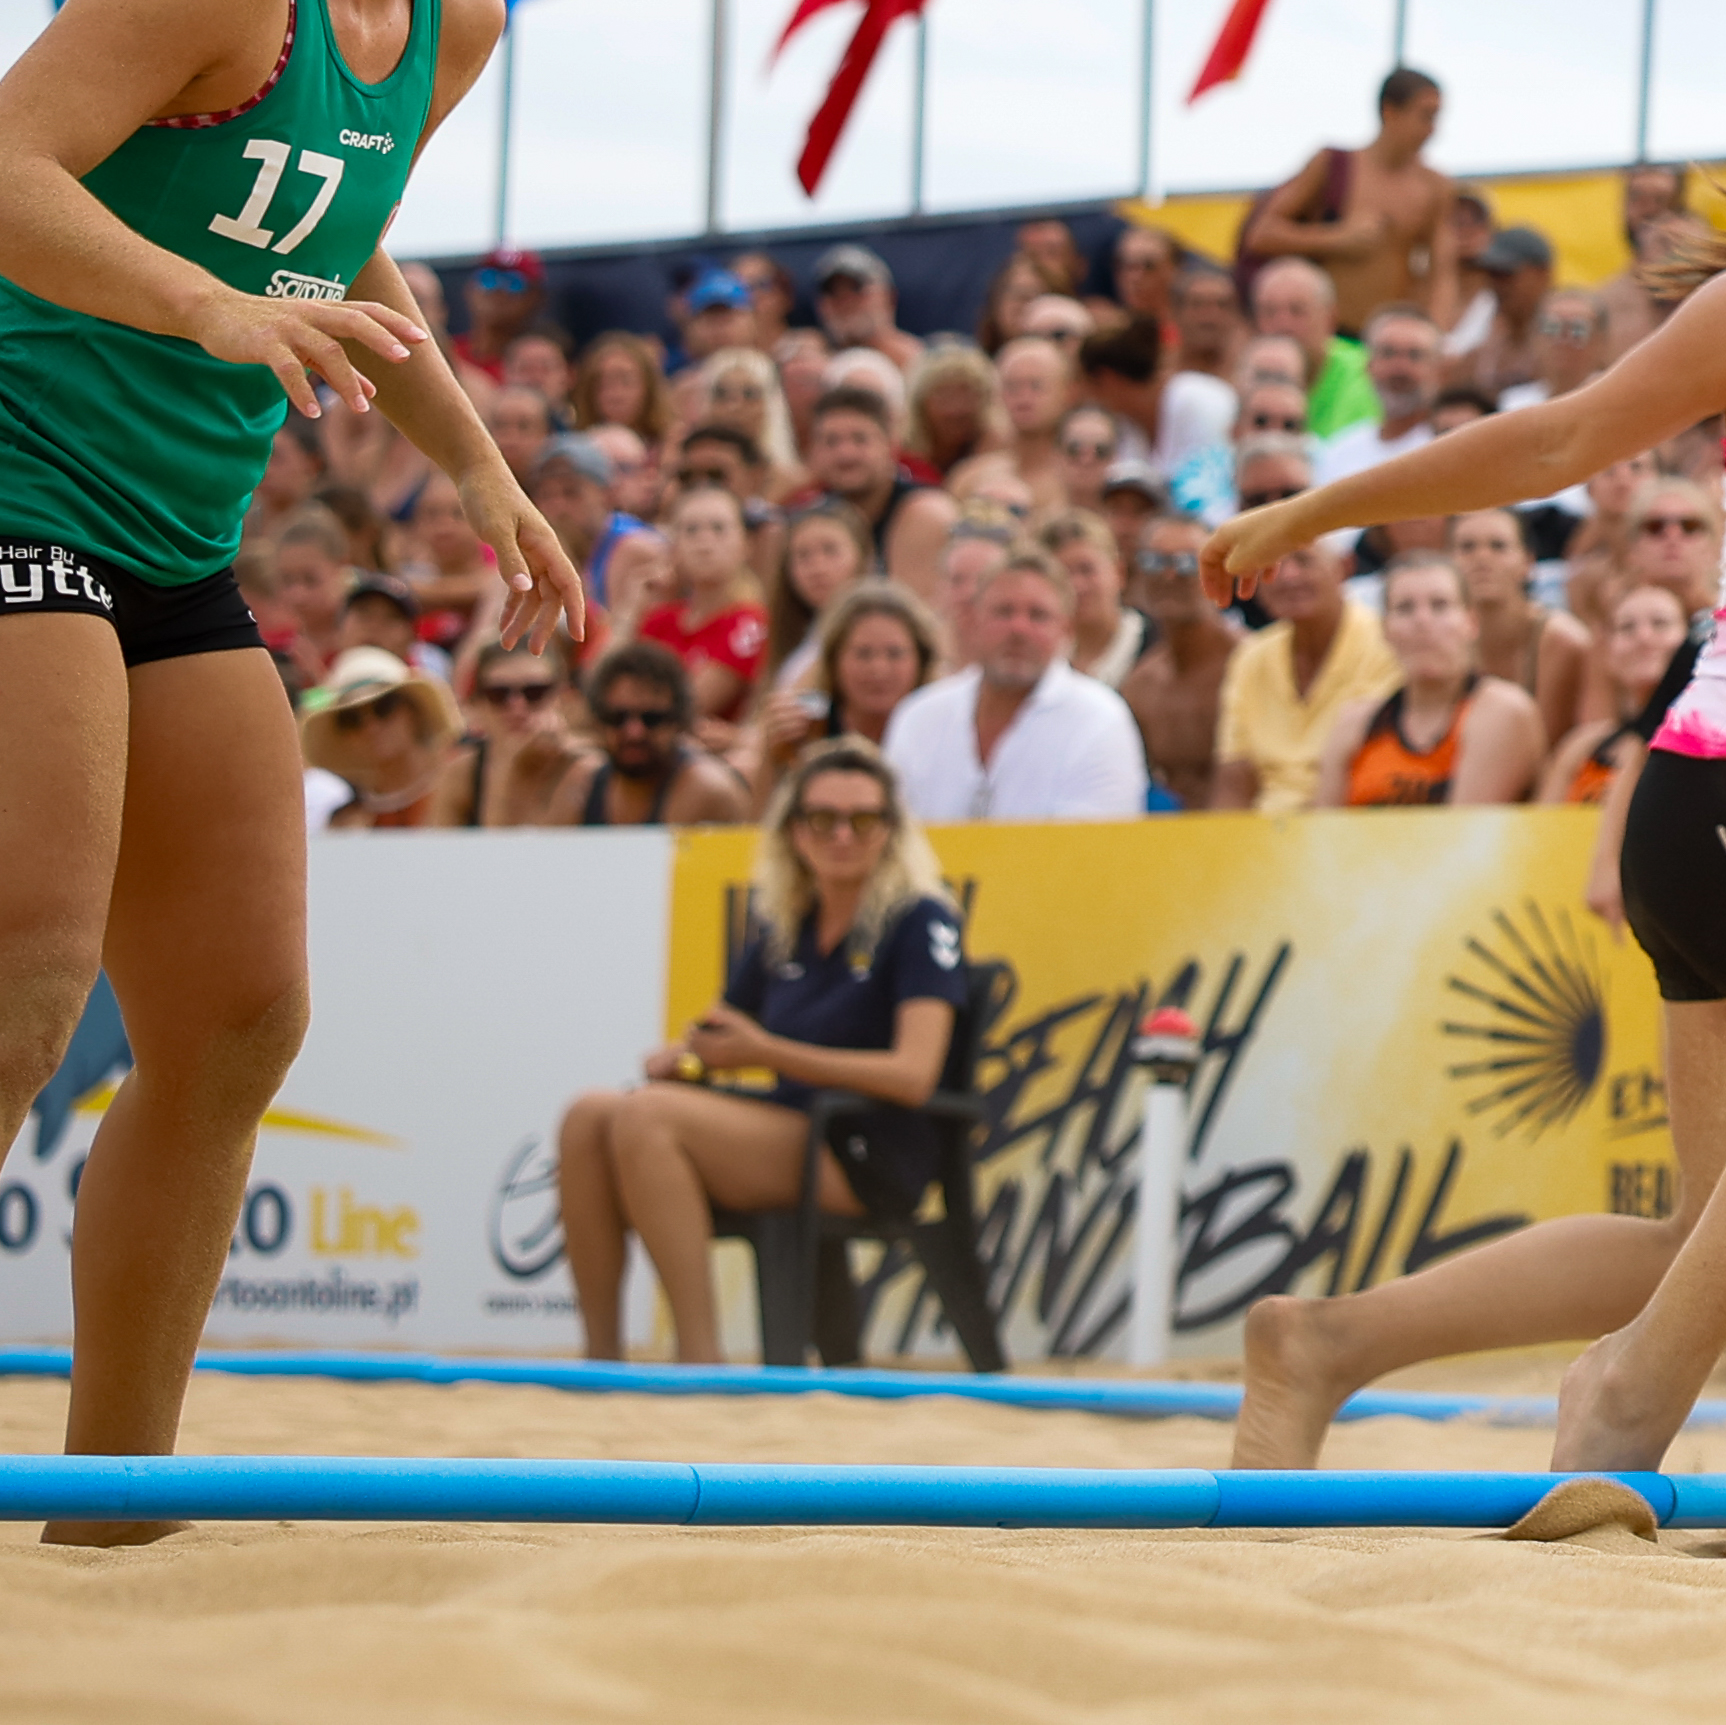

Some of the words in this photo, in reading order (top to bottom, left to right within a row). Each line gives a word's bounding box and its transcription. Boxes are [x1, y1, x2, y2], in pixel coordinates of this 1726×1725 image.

[339, 128, 384, 151] CRAFT
[208, 139, 345, 255] 17
[0, 545, 44, 560] Hair
[308, 1182, 421, 1258] Line
